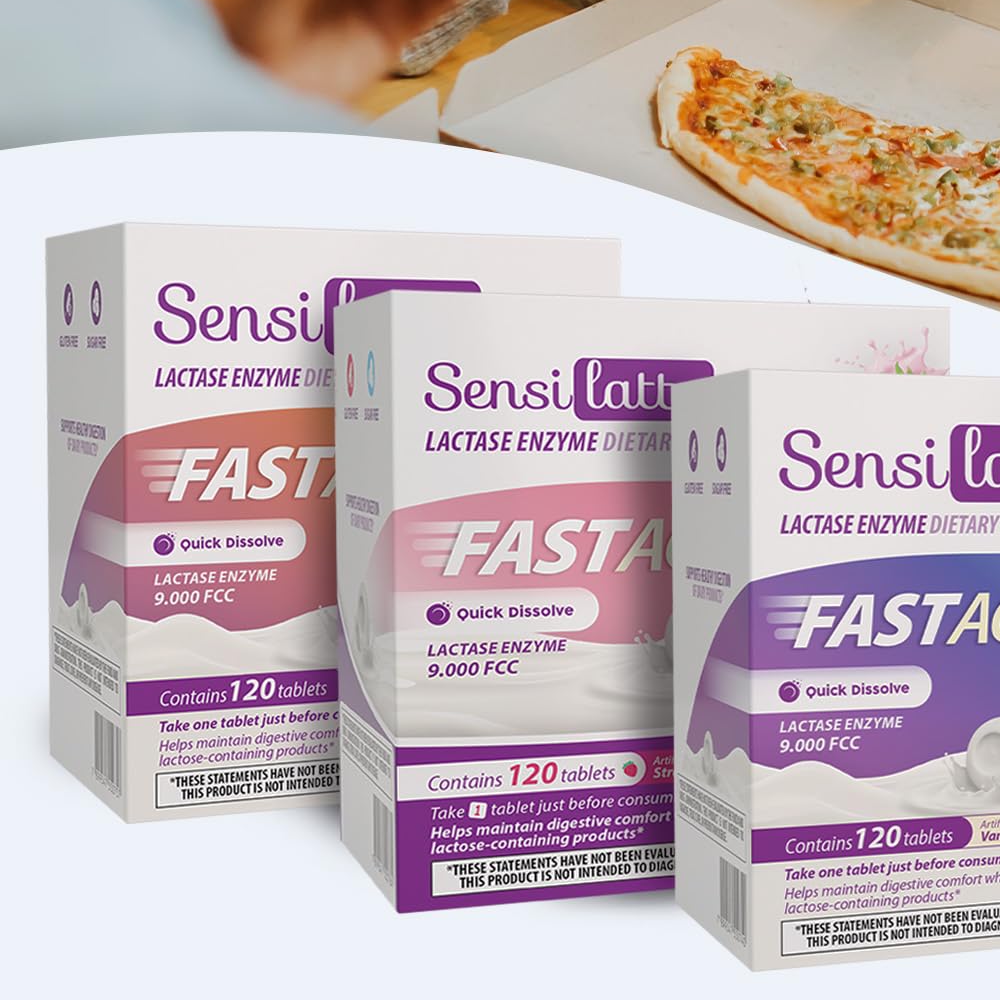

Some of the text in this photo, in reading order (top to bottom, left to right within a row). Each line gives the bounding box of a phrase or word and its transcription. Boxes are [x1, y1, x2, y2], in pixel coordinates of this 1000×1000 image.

[153, 282, 323, 345] Sensi
[155, 368, 229, 388] LACTASE
[231, 368, 302, 388] ENZYME
[424, 362, 573, 412] Sensi
[425, 431, 513, 452] LACTASE
[517, 431, 599, 452] ENZYME
[779, 429, 950, 492] Sensi
[780, 514, 854, 535] LACTASE
[857, 514, 928, 535] ENZYME
[929, 514, 1000, 535] DIETARY
[180, 535, 284, 552] Quick Dissolve
[443, 518, 672, 577] FASTA
[154, 568, 278, 586] LACTASE ENZYME
[154, 588, 235, 605] 9.000 FCC
[457, 604, 574, 622] Quick Dissolve
[427, 639, 567, 657] LACTASE ENZYME
[428, 660, 519, 678] 9.000 FCC
[159, 678, 328, 707] Contains 120 tablets
[805, 681, 910, 700] Quick Dissolve
[159, 721, 189, 733] Take
[193, 719, 217, 731] one
[221, 714, 259, 728] tablet
[260, 713, 286, 729] just
[289, 709, 329, 723] before
[779, 716, 903, 734] LACTASE ENZYME
[159, 739, 193, 753] Helps
[196, 735, 252, 750] maintain
[254, 729, 308, 748] digestive
[779, 735, 861, 754] 9.000 FCC
[159, 748, 273, 767] lactose-containing
[207, 769, 268, 785] STATEMENTS
[270, 767, 295, 779] HAVE
[297, 765, 317, 777] NOT
[427, 761, 616, 791] Contains 120 tablets
[181, 787, 204, 800] THIS
[206, 783, 252, 798] PRODUCT
[253, 782, 263, 794] IS
[265, 780, 284, 792] NOT
[286, 776, 333, 791] INTENDED
[431, 806, 465, 820] Take
[491, 800, 534, 816] tablet
[536, 799, 563, 816] just
[568, 795, 614, 811] before
[430, 810, 672, 840] Helps maintain digestive comfort
[430, 831, 568, 855] lactose-containing
[785, 825, 954, 856] Contains 120 tablets
[489, 856, 558, 873] STATEMENTS
[560, 854, 588, 867] HAVE
[591, 851, 612, 864] NOT
[614, 849, 642, 863] BEEN
[785, 868, 815, 881] Take
[818, 867, 843, 878] one
[846, 862, 885, 876] tablet
[885, 861, 912, 876] just
[914, 857, 956, 871] before
[459, 875, 486, 889] THIS
[488, 871, 540, 886] PRODUCT
[541, 870, 552, 882] IS
[554, 868, 576, 880] NOT
[578, 864, 632, 879] INTENDED
[634, 862, 647, 874] TO
[784, 887, 819, 901] Helps
[822, 882, 878, 898] maintain
[880, 876, 934, 896] digestive
[935, 873, 982, 888] comfort
[784, 896, 900, 915] lactose-containing
[833, 916, 895, 933] STATEMENTS
[896, 913, 922, 926] HAVE
[923, 911, 943, 924] NOT
[944, 909, 970, 923] BEEN
[806, 935, 830, 948] THIS
[832, 930, 878, 946] PRODUCT
[879, 929, 889, 942] IS
[890, 927, 910, 940] NOT
[912, 922, 960, 939] INTENDED
[962, 921, 974, 934] TO
